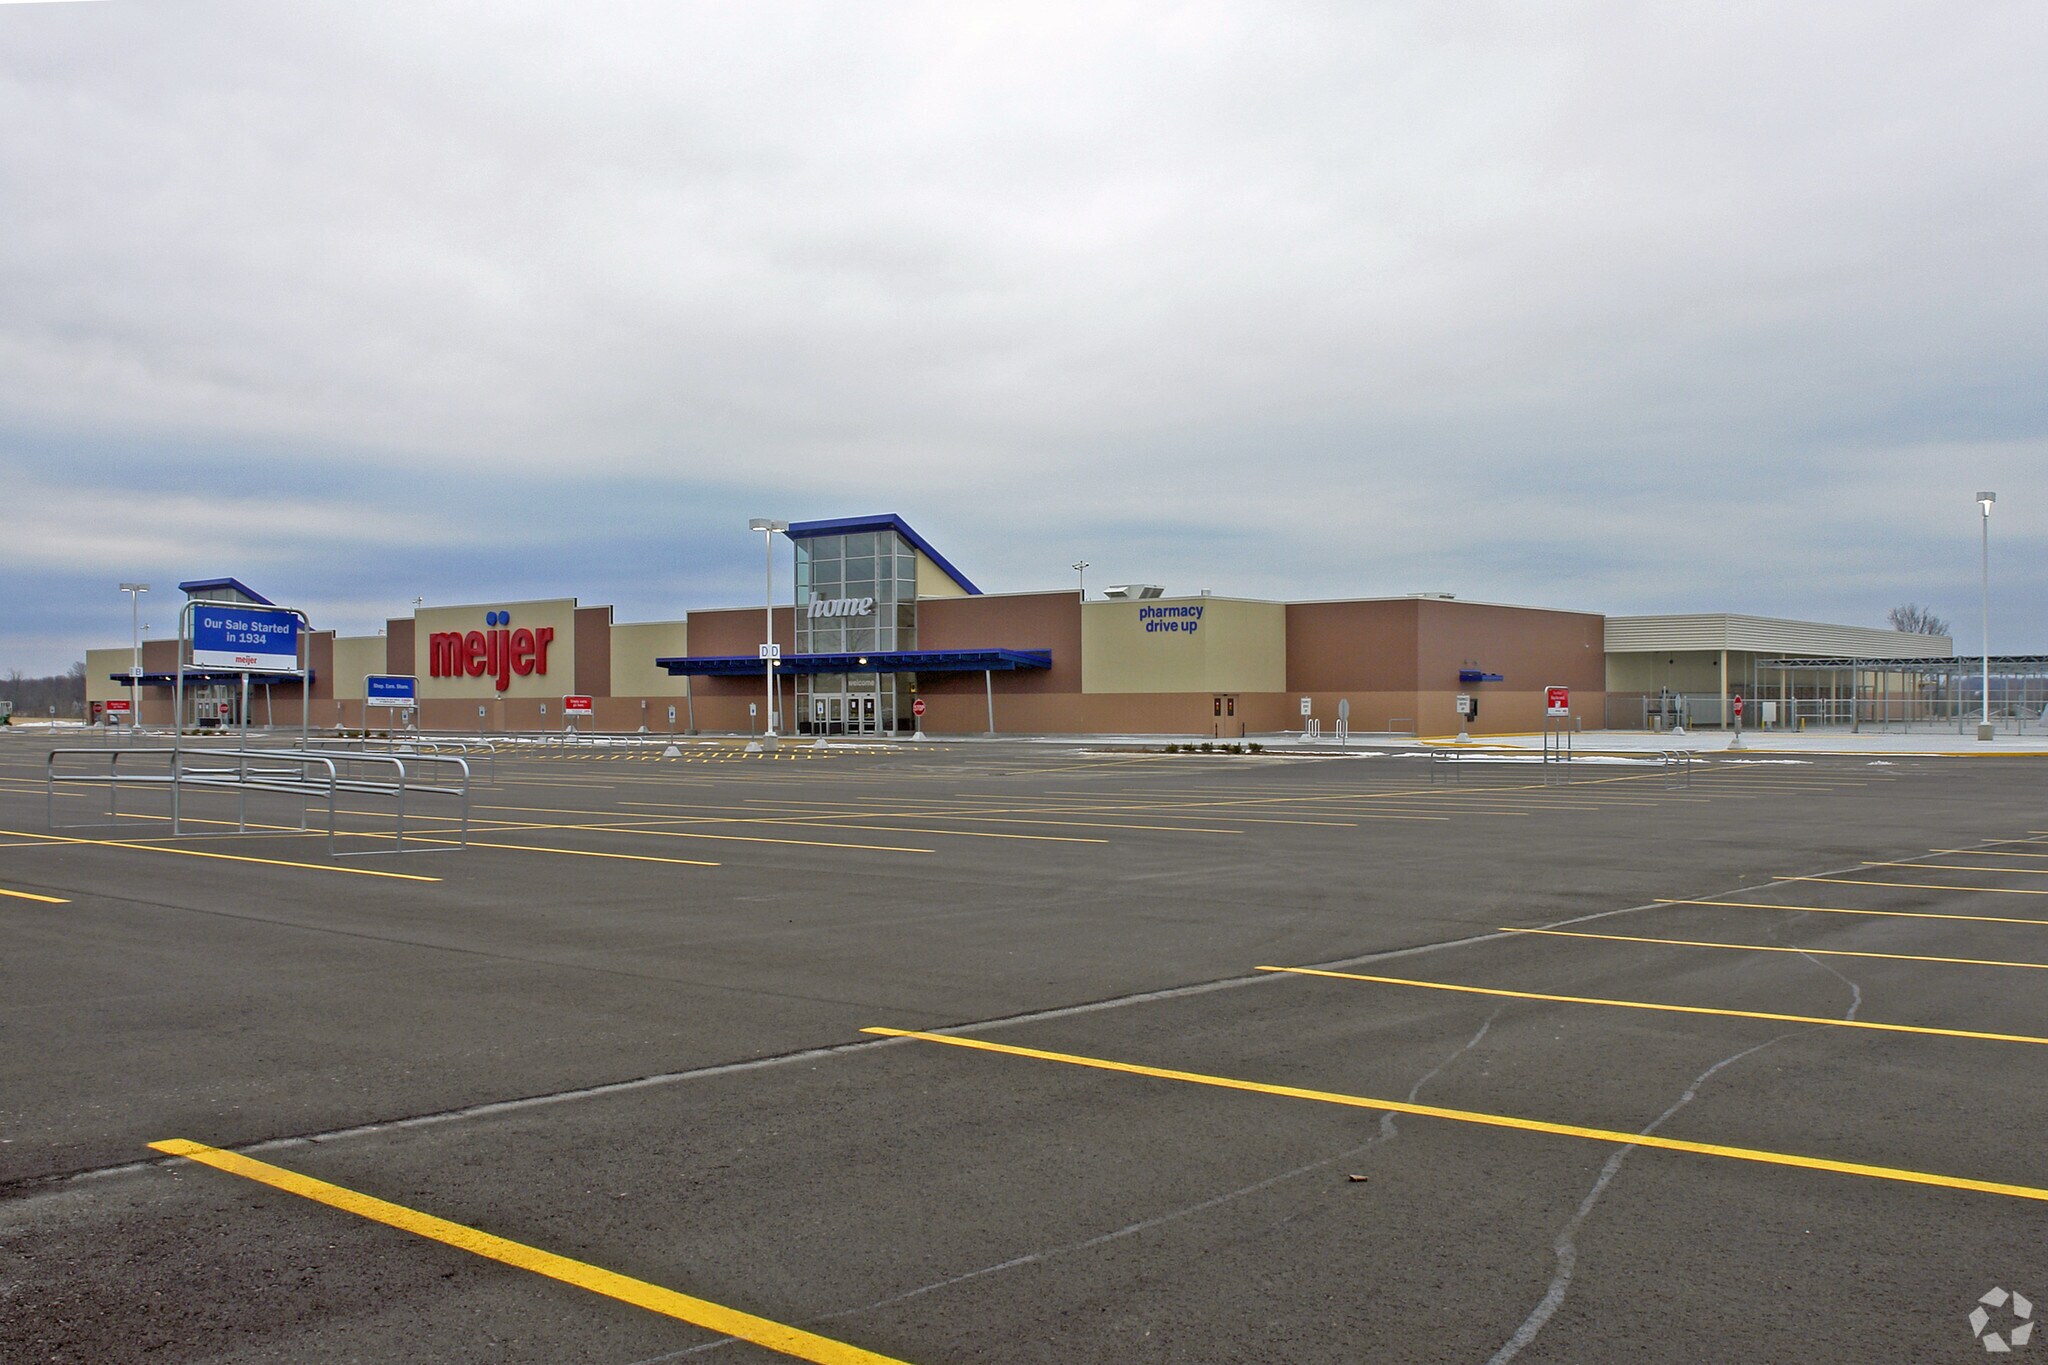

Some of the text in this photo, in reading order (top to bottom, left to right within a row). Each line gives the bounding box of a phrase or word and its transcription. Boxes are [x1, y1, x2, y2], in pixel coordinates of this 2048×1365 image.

[807, 592, 875, 618] home
[1139, 605, 1204, 621] pharmacy
[204, 618, 290, 634] Our Sale Started
[1146, 619, 1198, 634] drive up
[226, 631, 267, 645] in 1934
[429, 610, 554, 692] meijer
[761, 646, 768, 657] D
[772, 646, 778, 657] D
[235, 655, 257, 665] meijer
